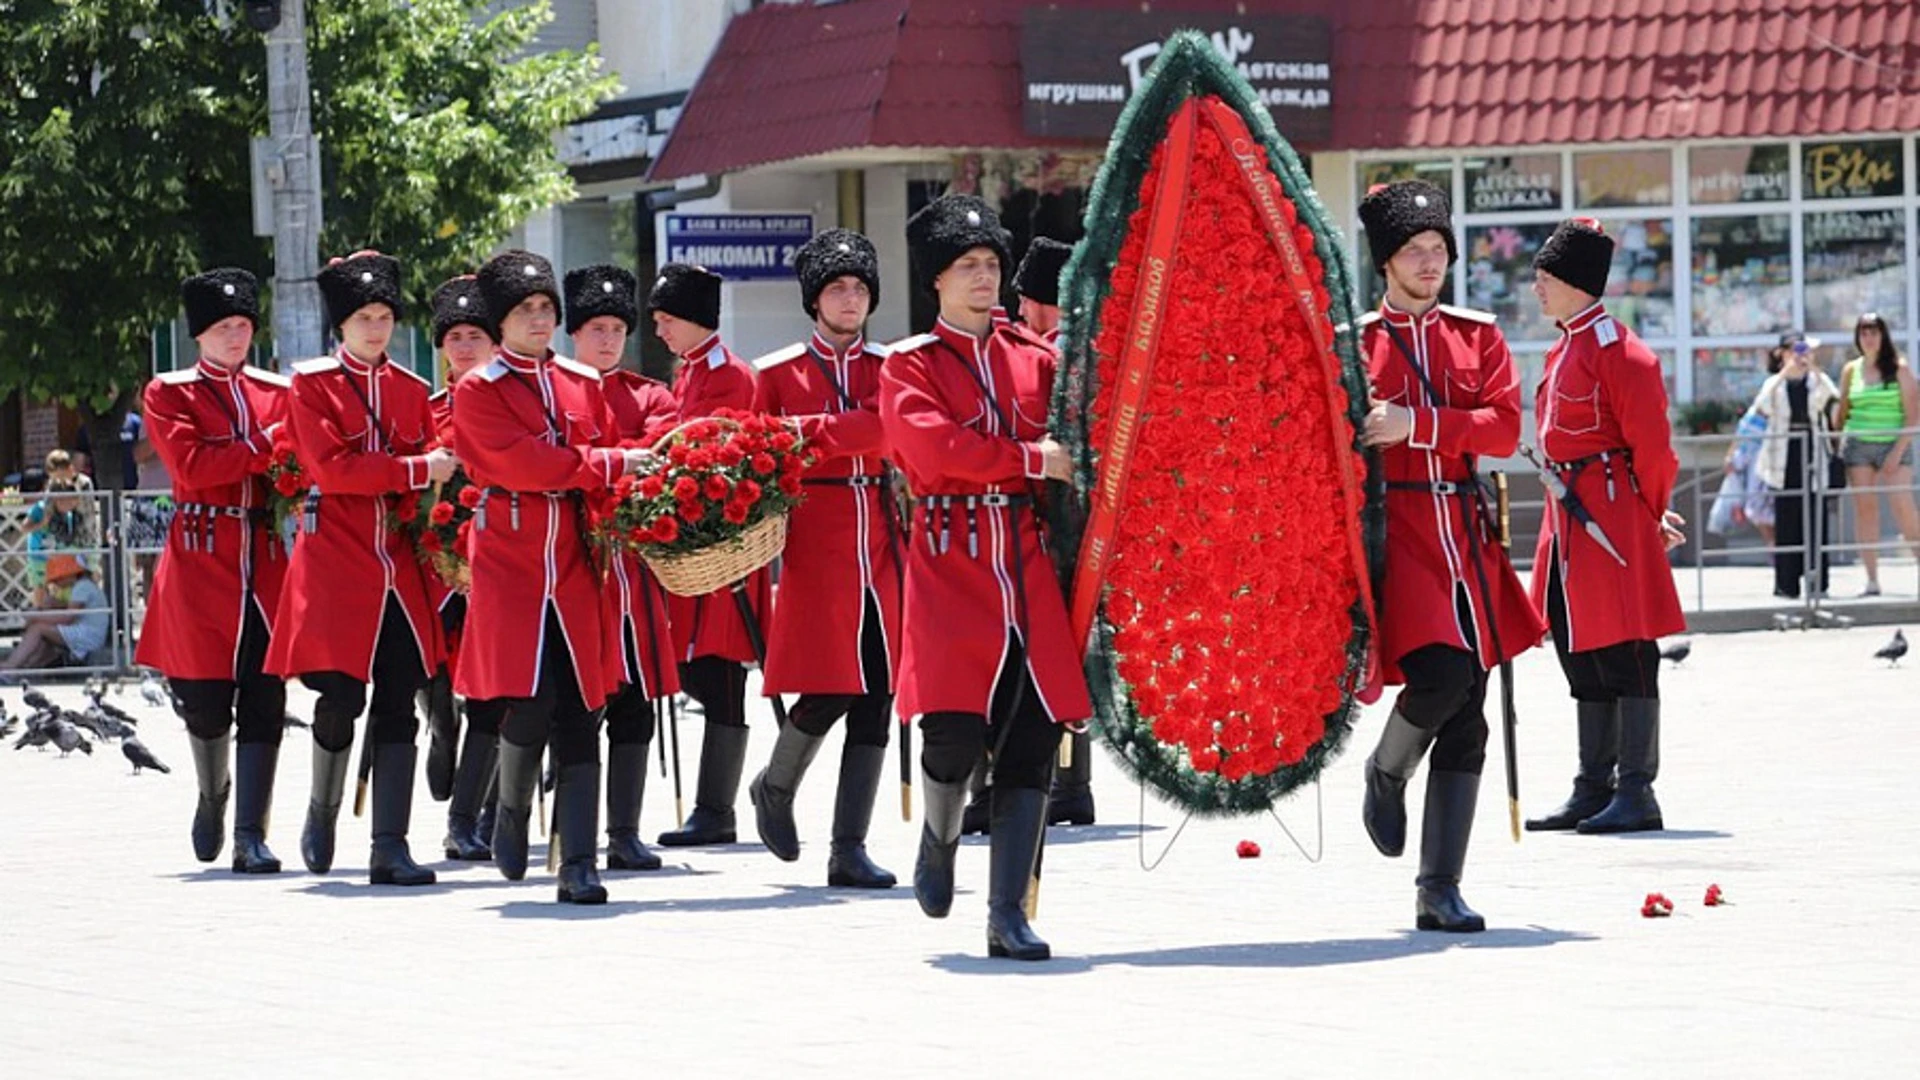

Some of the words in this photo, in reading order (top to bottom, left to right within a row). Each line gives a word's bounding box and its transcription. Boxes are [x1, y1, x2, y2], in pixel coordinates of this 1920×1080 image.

[1028, 82, 1125, 104] игрушки
[1257, 87, 1330, 109] дежда
[764, 218, 810, 230] КРЕДИТ
[672, 245, 778, 267] БАНКОМАТ
